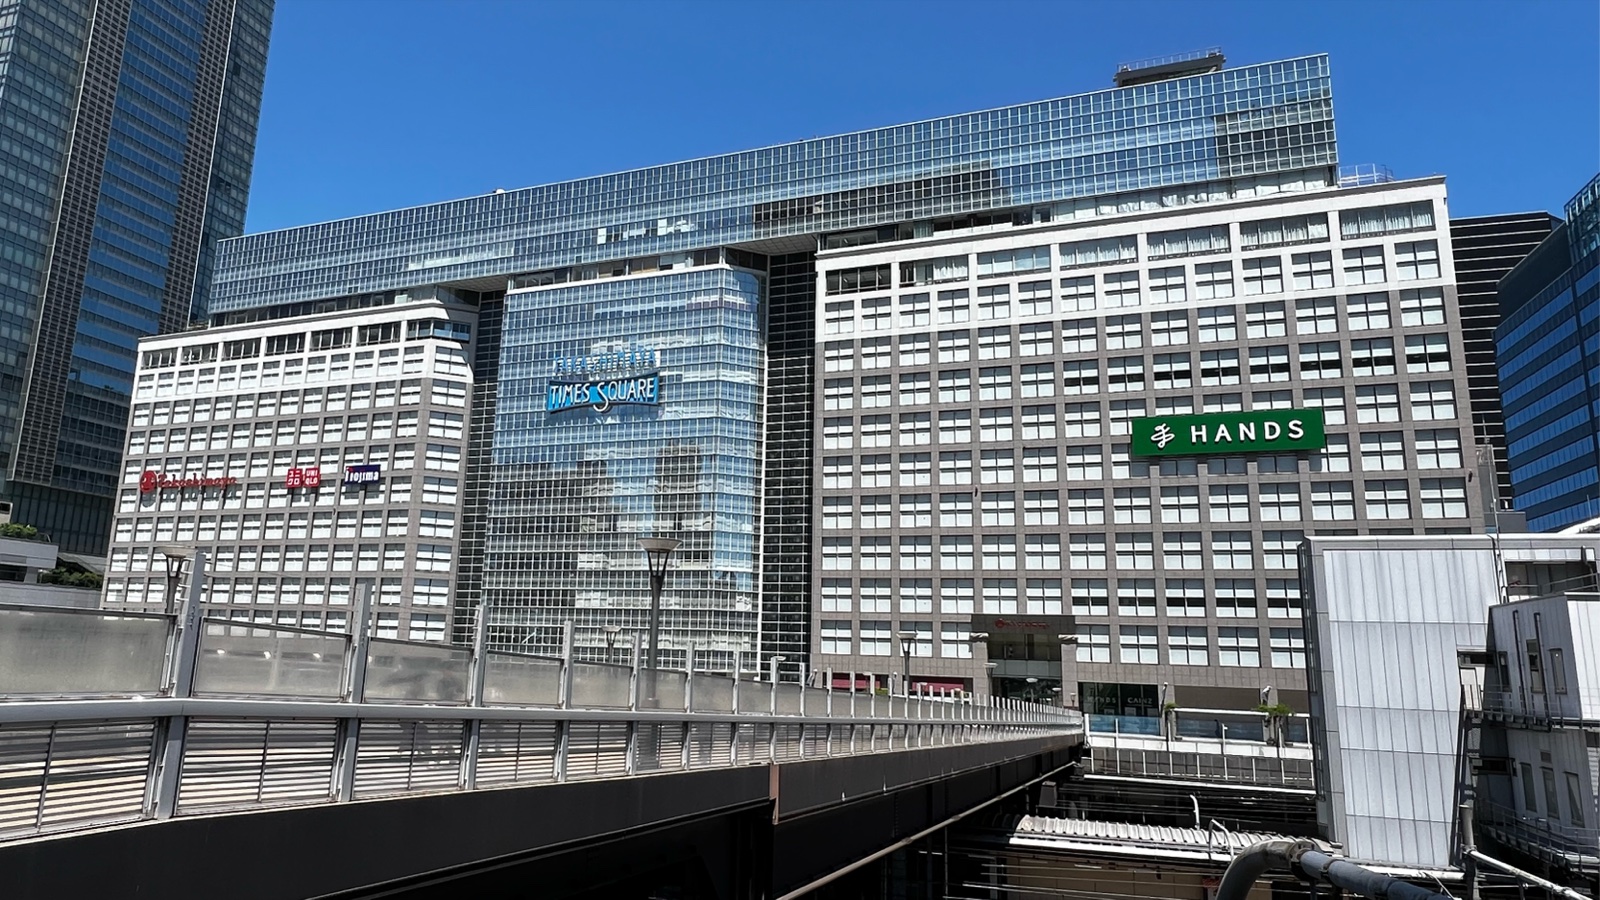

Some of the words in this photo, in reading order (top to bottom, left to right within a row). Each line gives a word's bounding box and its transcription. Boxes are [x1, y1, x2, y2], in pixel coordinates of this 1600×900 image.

[551, 383, 590, 404] TIMES
[593, 378, 654, 412] SQUARE
[1191, 420, 1304, 443] HANDS
[158, 473, 237, 489] Takashimaya
